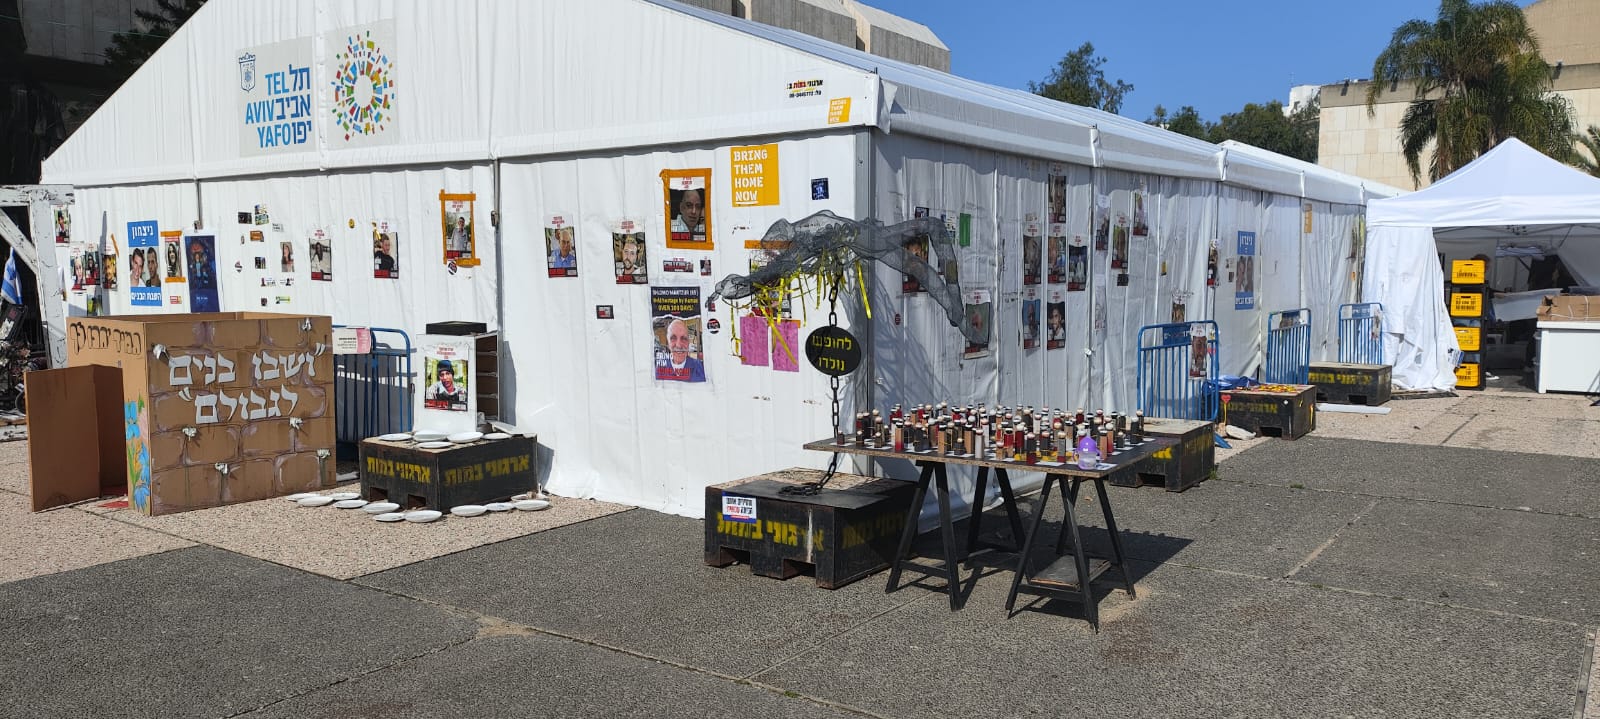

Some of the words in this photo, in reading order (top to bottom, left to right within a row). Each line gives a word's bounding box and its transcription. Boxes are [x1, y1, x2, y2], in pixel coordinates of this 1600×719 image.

[265, 71, 289, 96] TEL
[289, 64, 310, 92] תל
[245, 99, 275, 125] AVIV
[275, 94, 311, 120] אביב
[257, 123, 291, 148] YAFO
[291, 121, 312, 144] יפו
[733, 149, 768, 162] BRING
[734, 163, 763, 174] THEM
[734, 176, 764, 188] HOME
[735, 190, 759, 201] NOW
[131, 225, 154, 240] ניצחון
[812, 335, 852, 351] לחופש
[169, 352, 236, 386] בנים
[818, 356, 845, 371] נולדו
[367, 456, 395, 476] במות
[396, 462, 431, 484] ארגוני
[444, 462, 483, 486] במות
[485, 453, 530, 480] ארגוני
